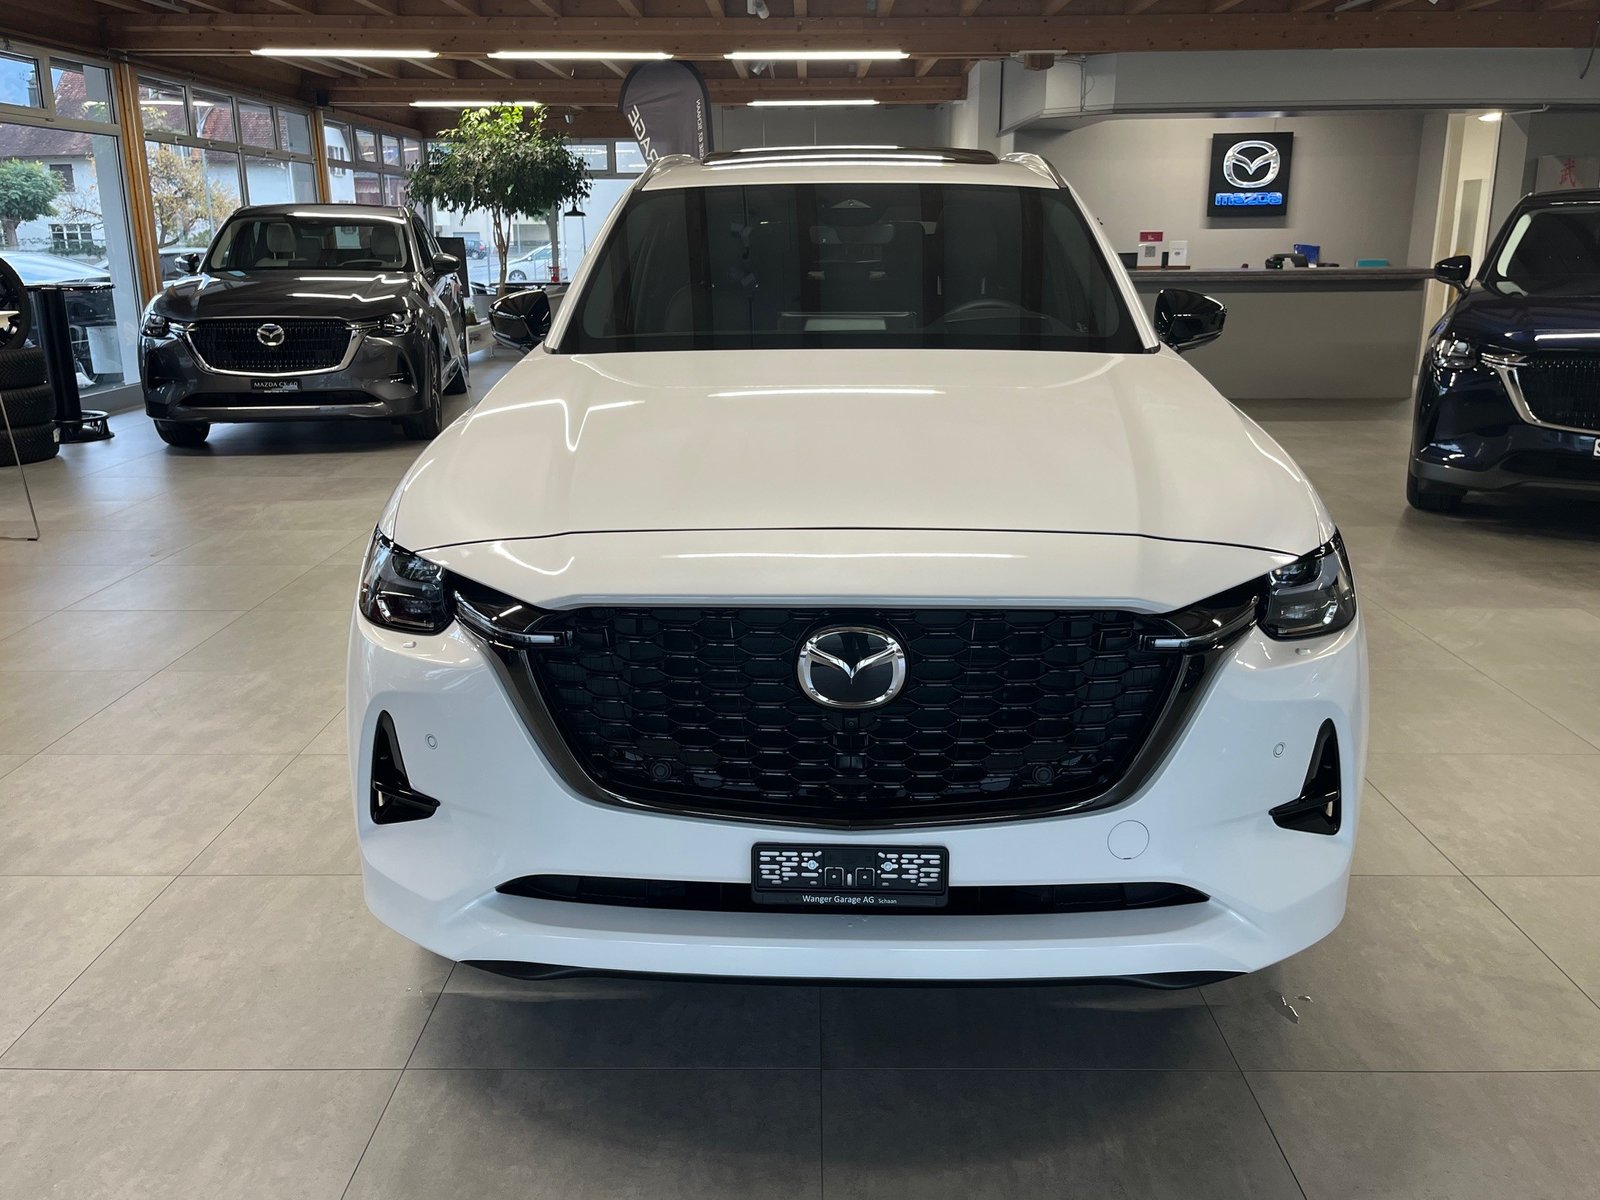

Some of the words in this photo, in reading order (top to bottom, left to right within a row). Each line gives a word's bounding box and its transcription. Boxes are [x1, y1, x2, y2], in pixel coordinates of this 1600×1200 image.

[1215, 192, 1282, 206] mazda
[802, 895, 832, 904] Wanger
[833, 895, 861, 905] Garage
[862, 896, 875, 904] AG
